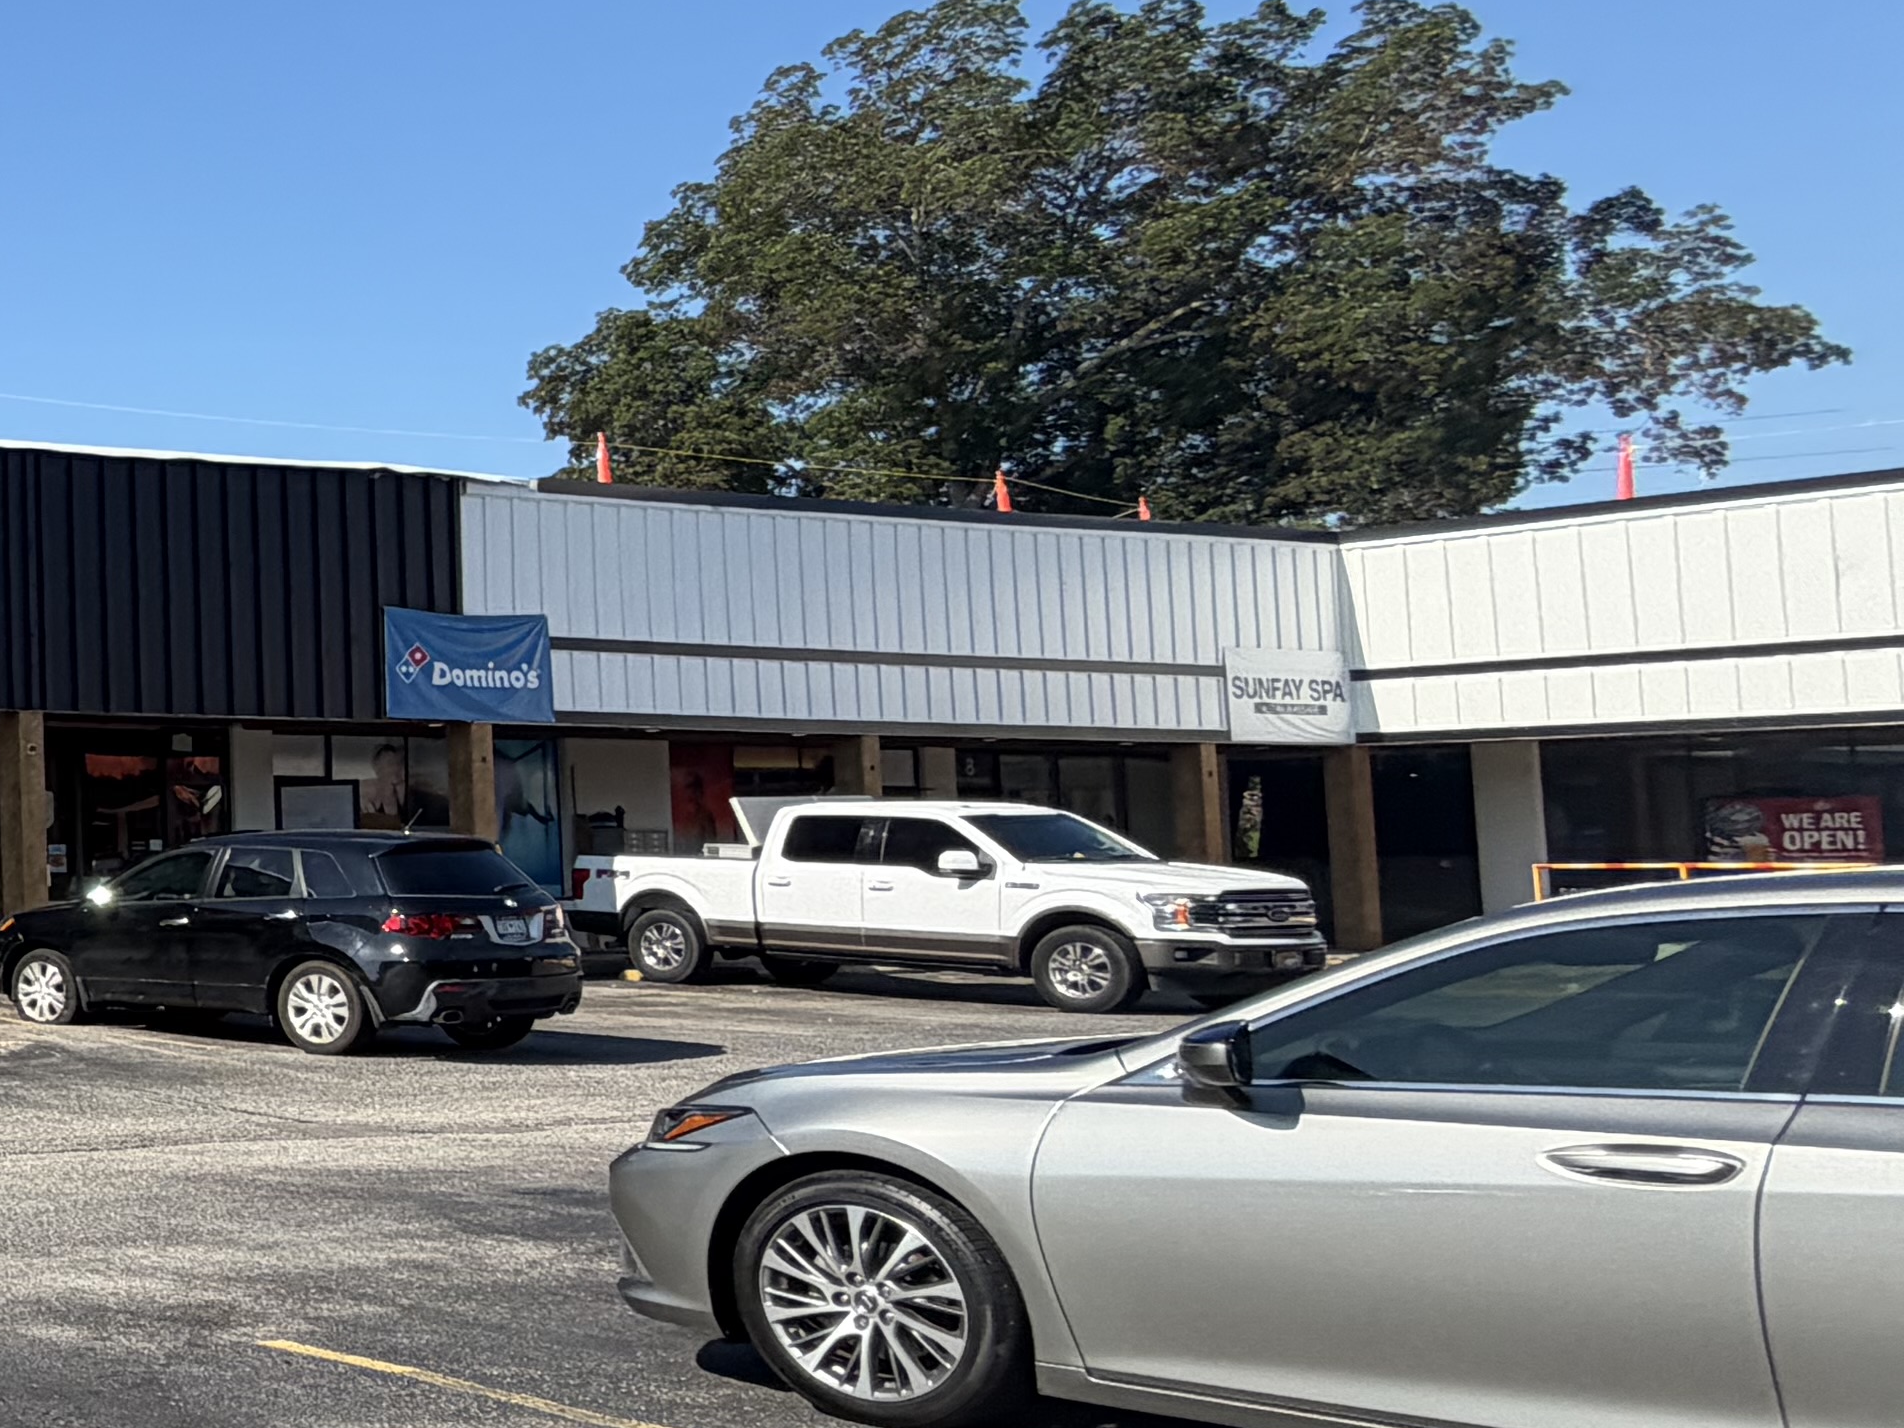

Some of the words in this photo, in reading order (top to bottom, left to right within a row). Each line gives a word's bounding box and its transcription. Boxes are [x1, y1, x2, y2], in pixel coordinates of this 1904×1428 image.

[431, 661, 540, 689] Domino's
[1231, 675, 1304, 701] SUNFAY
[1307, 678, 1347, 703] SPA
[1780, 812, 1816, 829] WE
[1819, 811, 1864, 829] ARE
[1781, 830, 1869, 851] OPEN!
